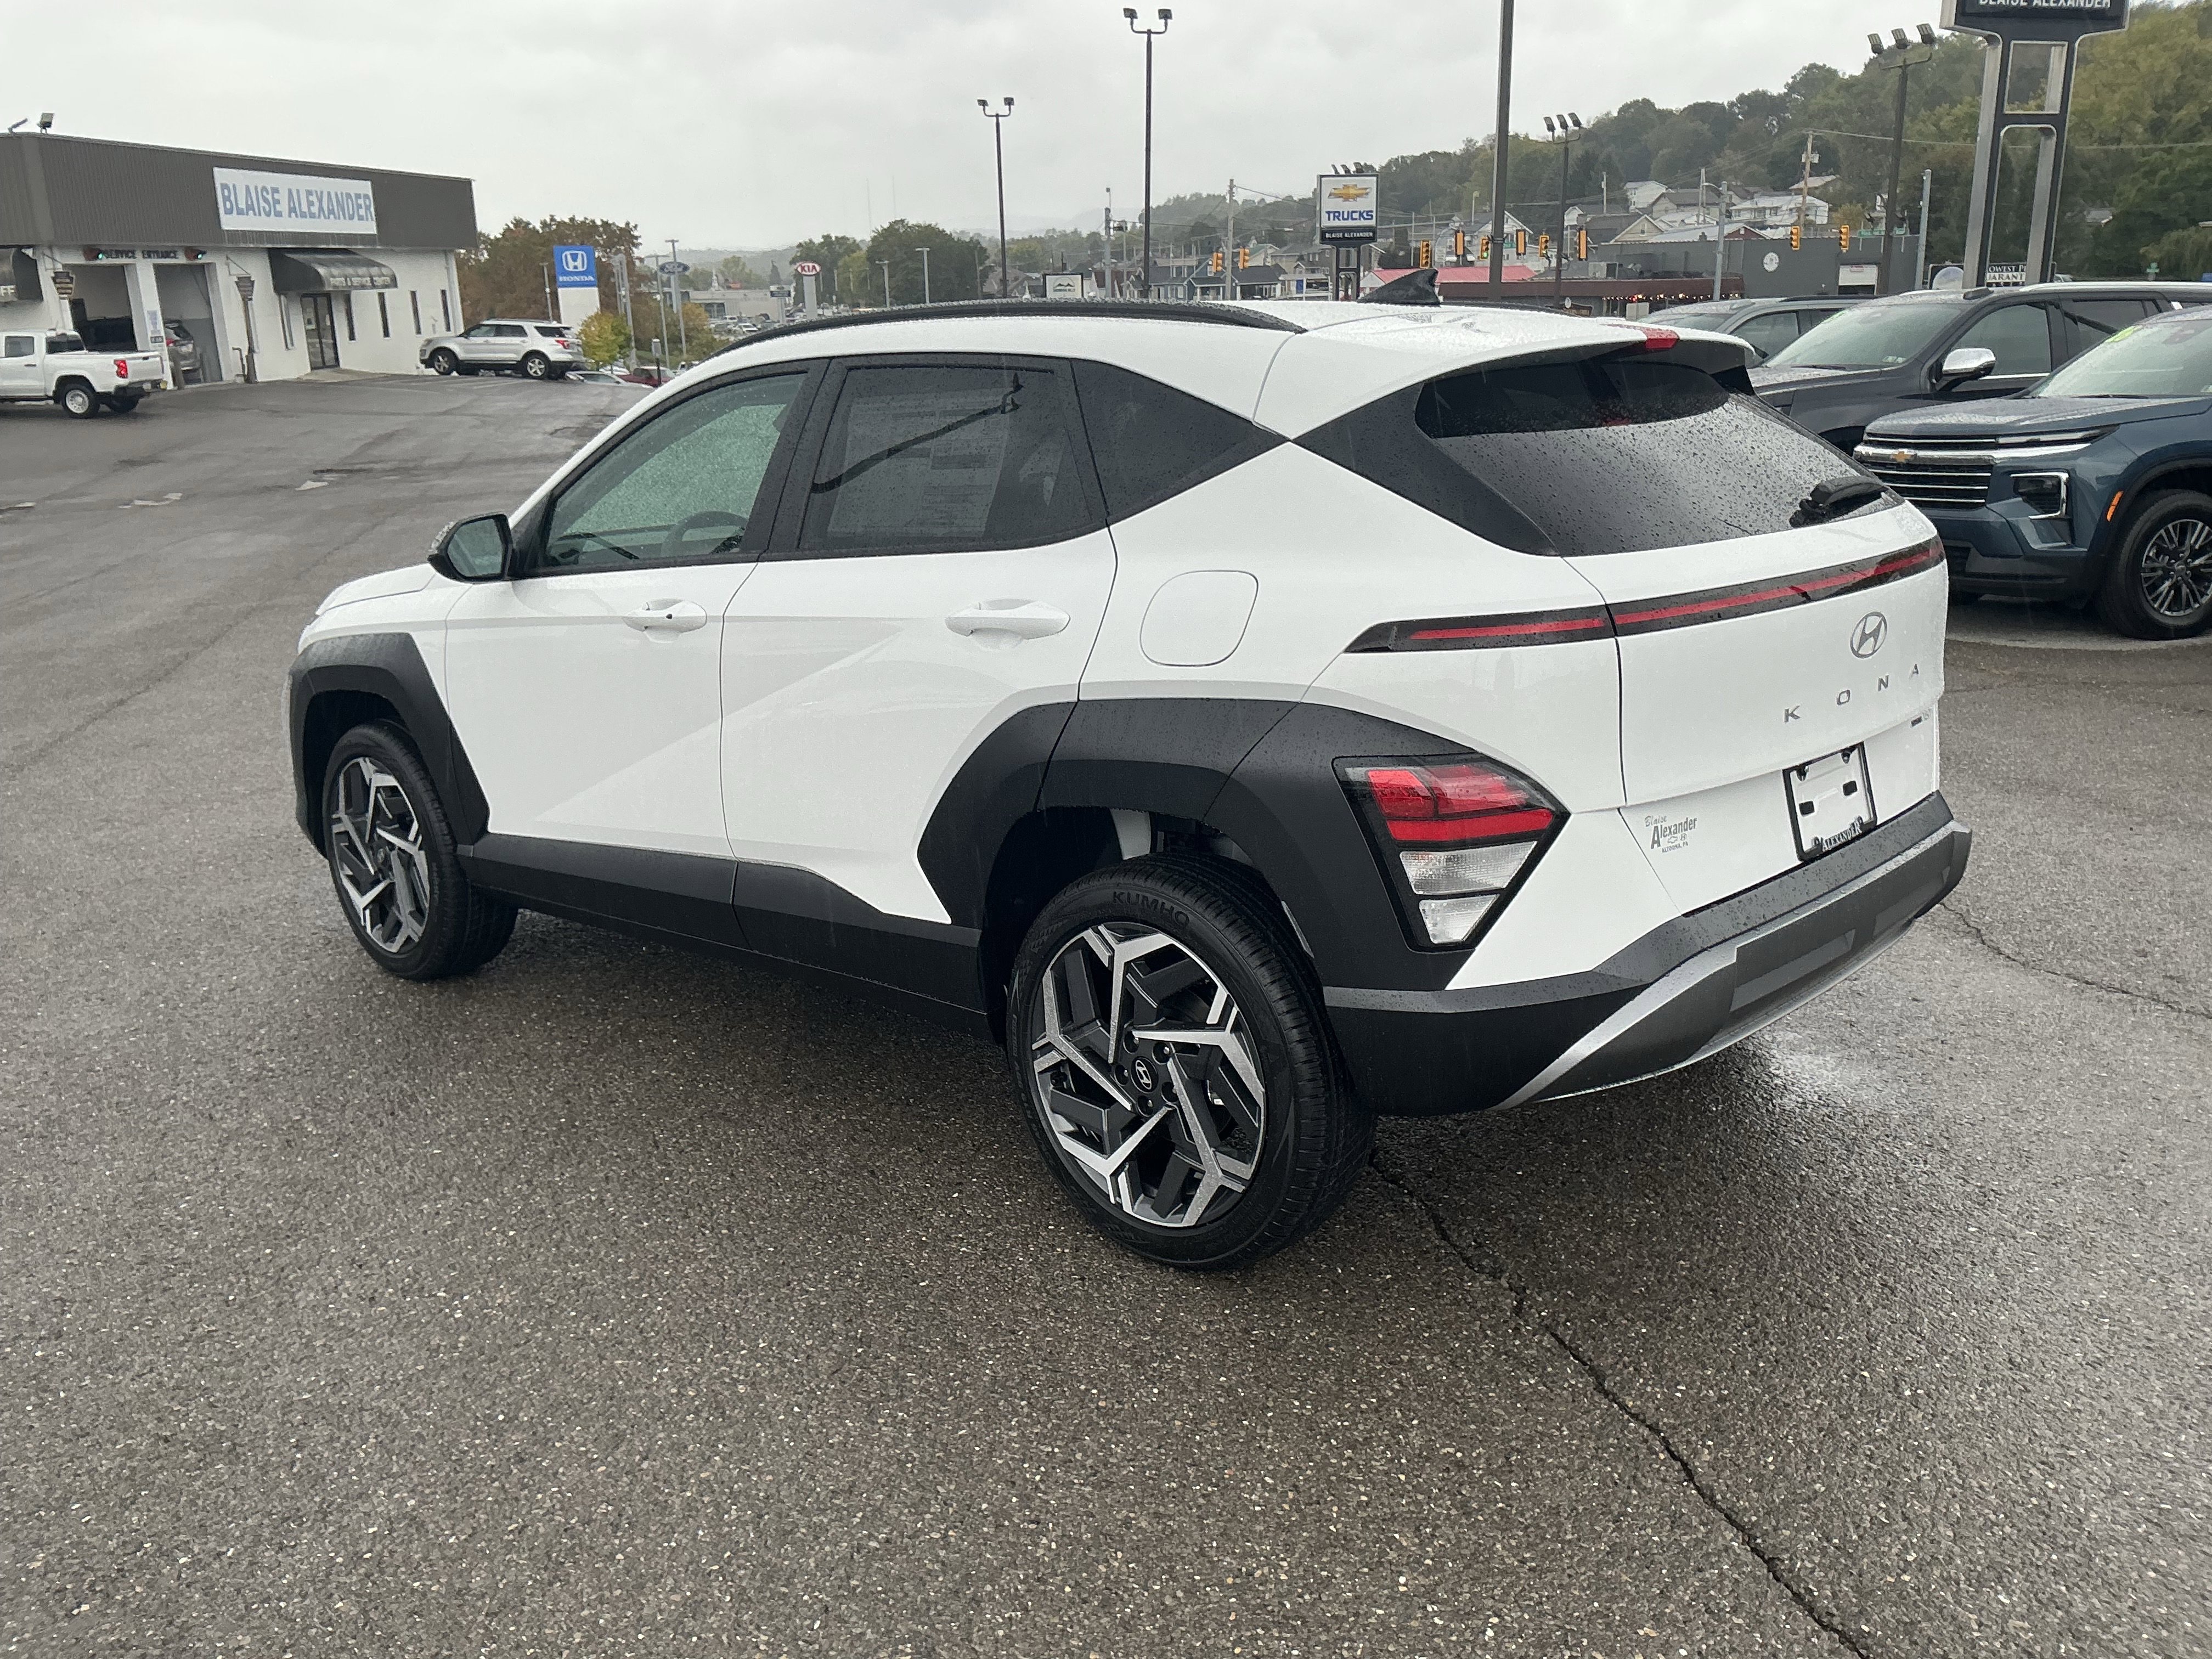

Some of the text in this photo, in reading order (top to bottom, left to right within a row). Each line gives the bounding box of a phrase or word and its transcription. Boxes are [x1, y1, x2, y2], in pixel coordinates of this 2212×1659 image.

[220, 183, 374, 222] BLAISE ALEXANDER
[1325, 210, 1374, 221] TRUCKS
[800, 264, 817, 273] KIA
[1784, 663, 1919, 723] KONA
[1645, 815, 1667, 827] Blaise
[1650, 817, 1697, 850] Alexander
[1822, 820, 1863, 852] ALEXANDER
[1113, 890, 1190, 928] KUMHO
